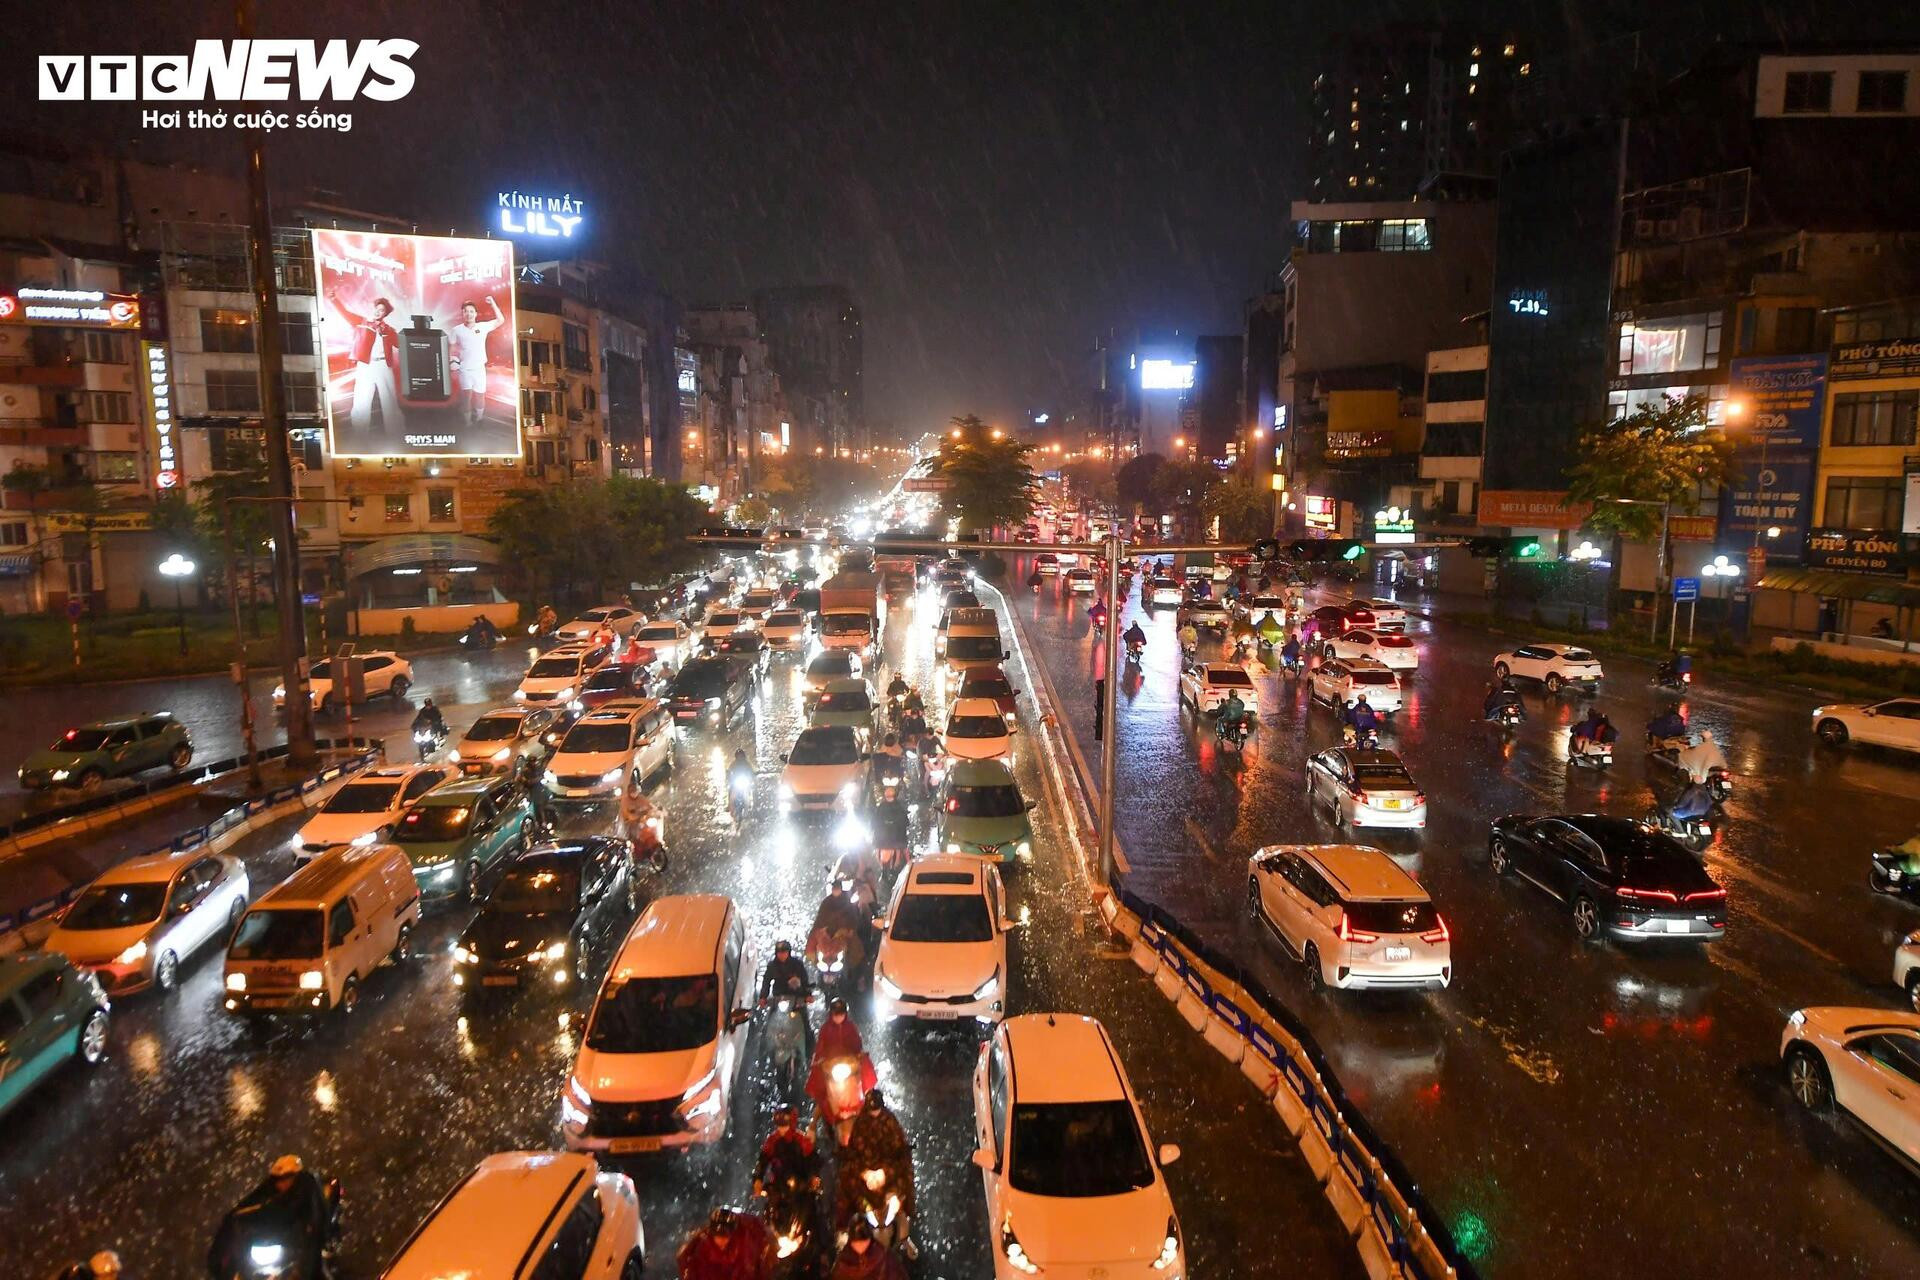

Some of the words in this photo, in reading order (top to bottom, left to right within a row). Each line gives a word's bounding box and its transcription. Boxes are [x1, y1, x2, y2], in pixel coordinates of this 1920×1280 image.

[498, 190, 543, 210] KÍNH
[547, 193, 584, 214] MẮT
[501, 208, 583, 237] LILY
[1613, 310, 1634, 321] 393
[404, 434, 433, 444] RHYS
[433, 434, 456, 444] MAN
